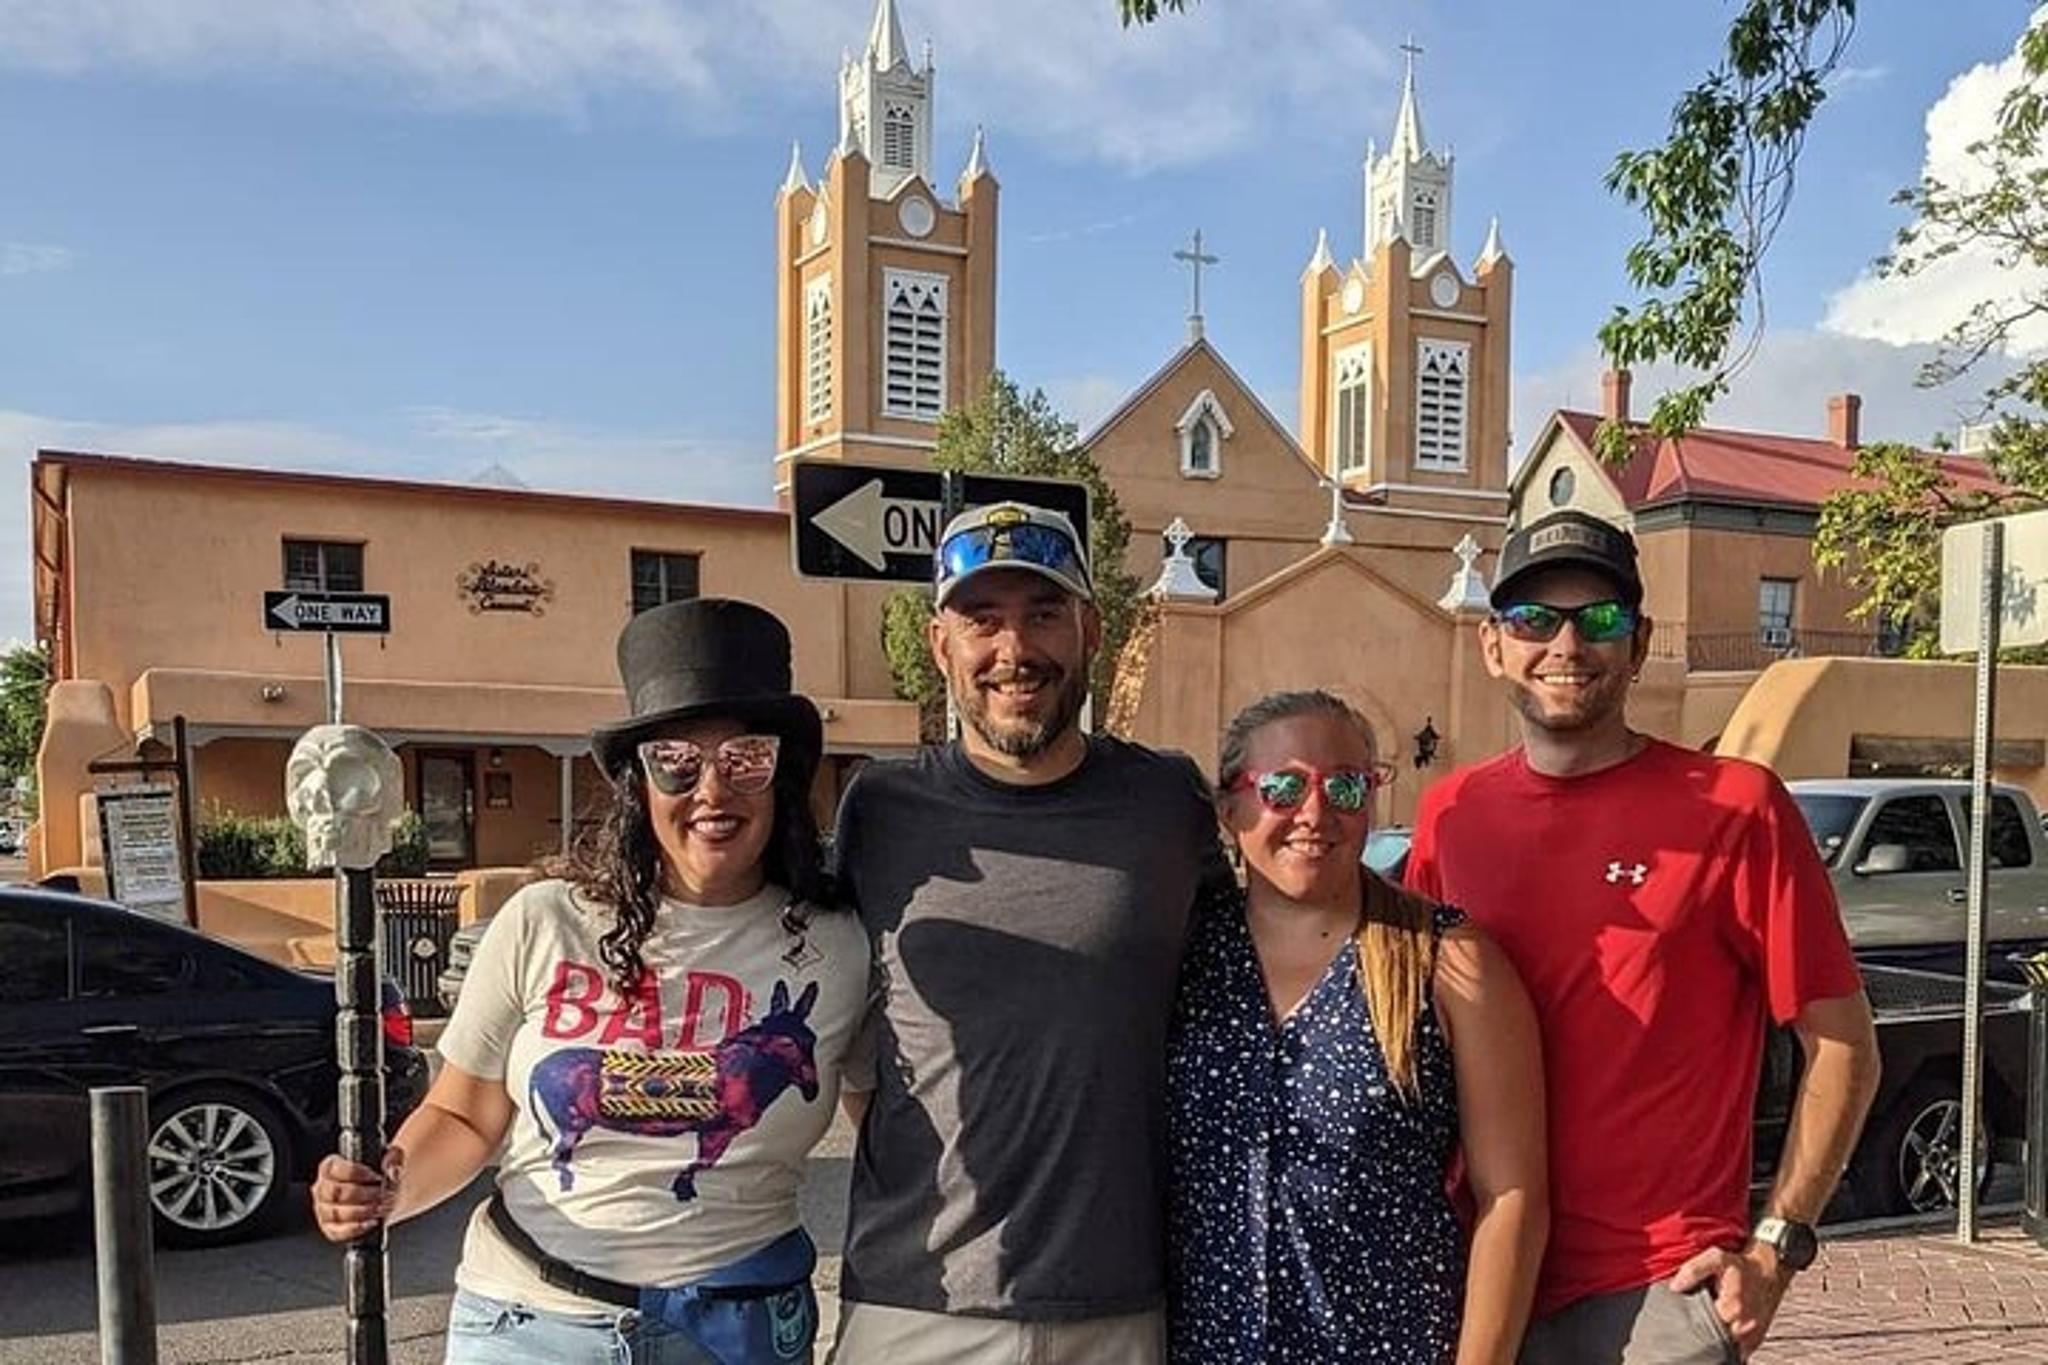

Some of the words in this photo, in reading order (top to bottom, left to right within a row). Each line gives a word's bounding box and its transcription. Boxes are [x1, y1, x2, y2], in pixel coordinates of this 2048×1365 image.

[296, 605, 330, 620] ONE
[342, 606, 378, 620] WAY
[542, 960, 744, 1053] BAD
